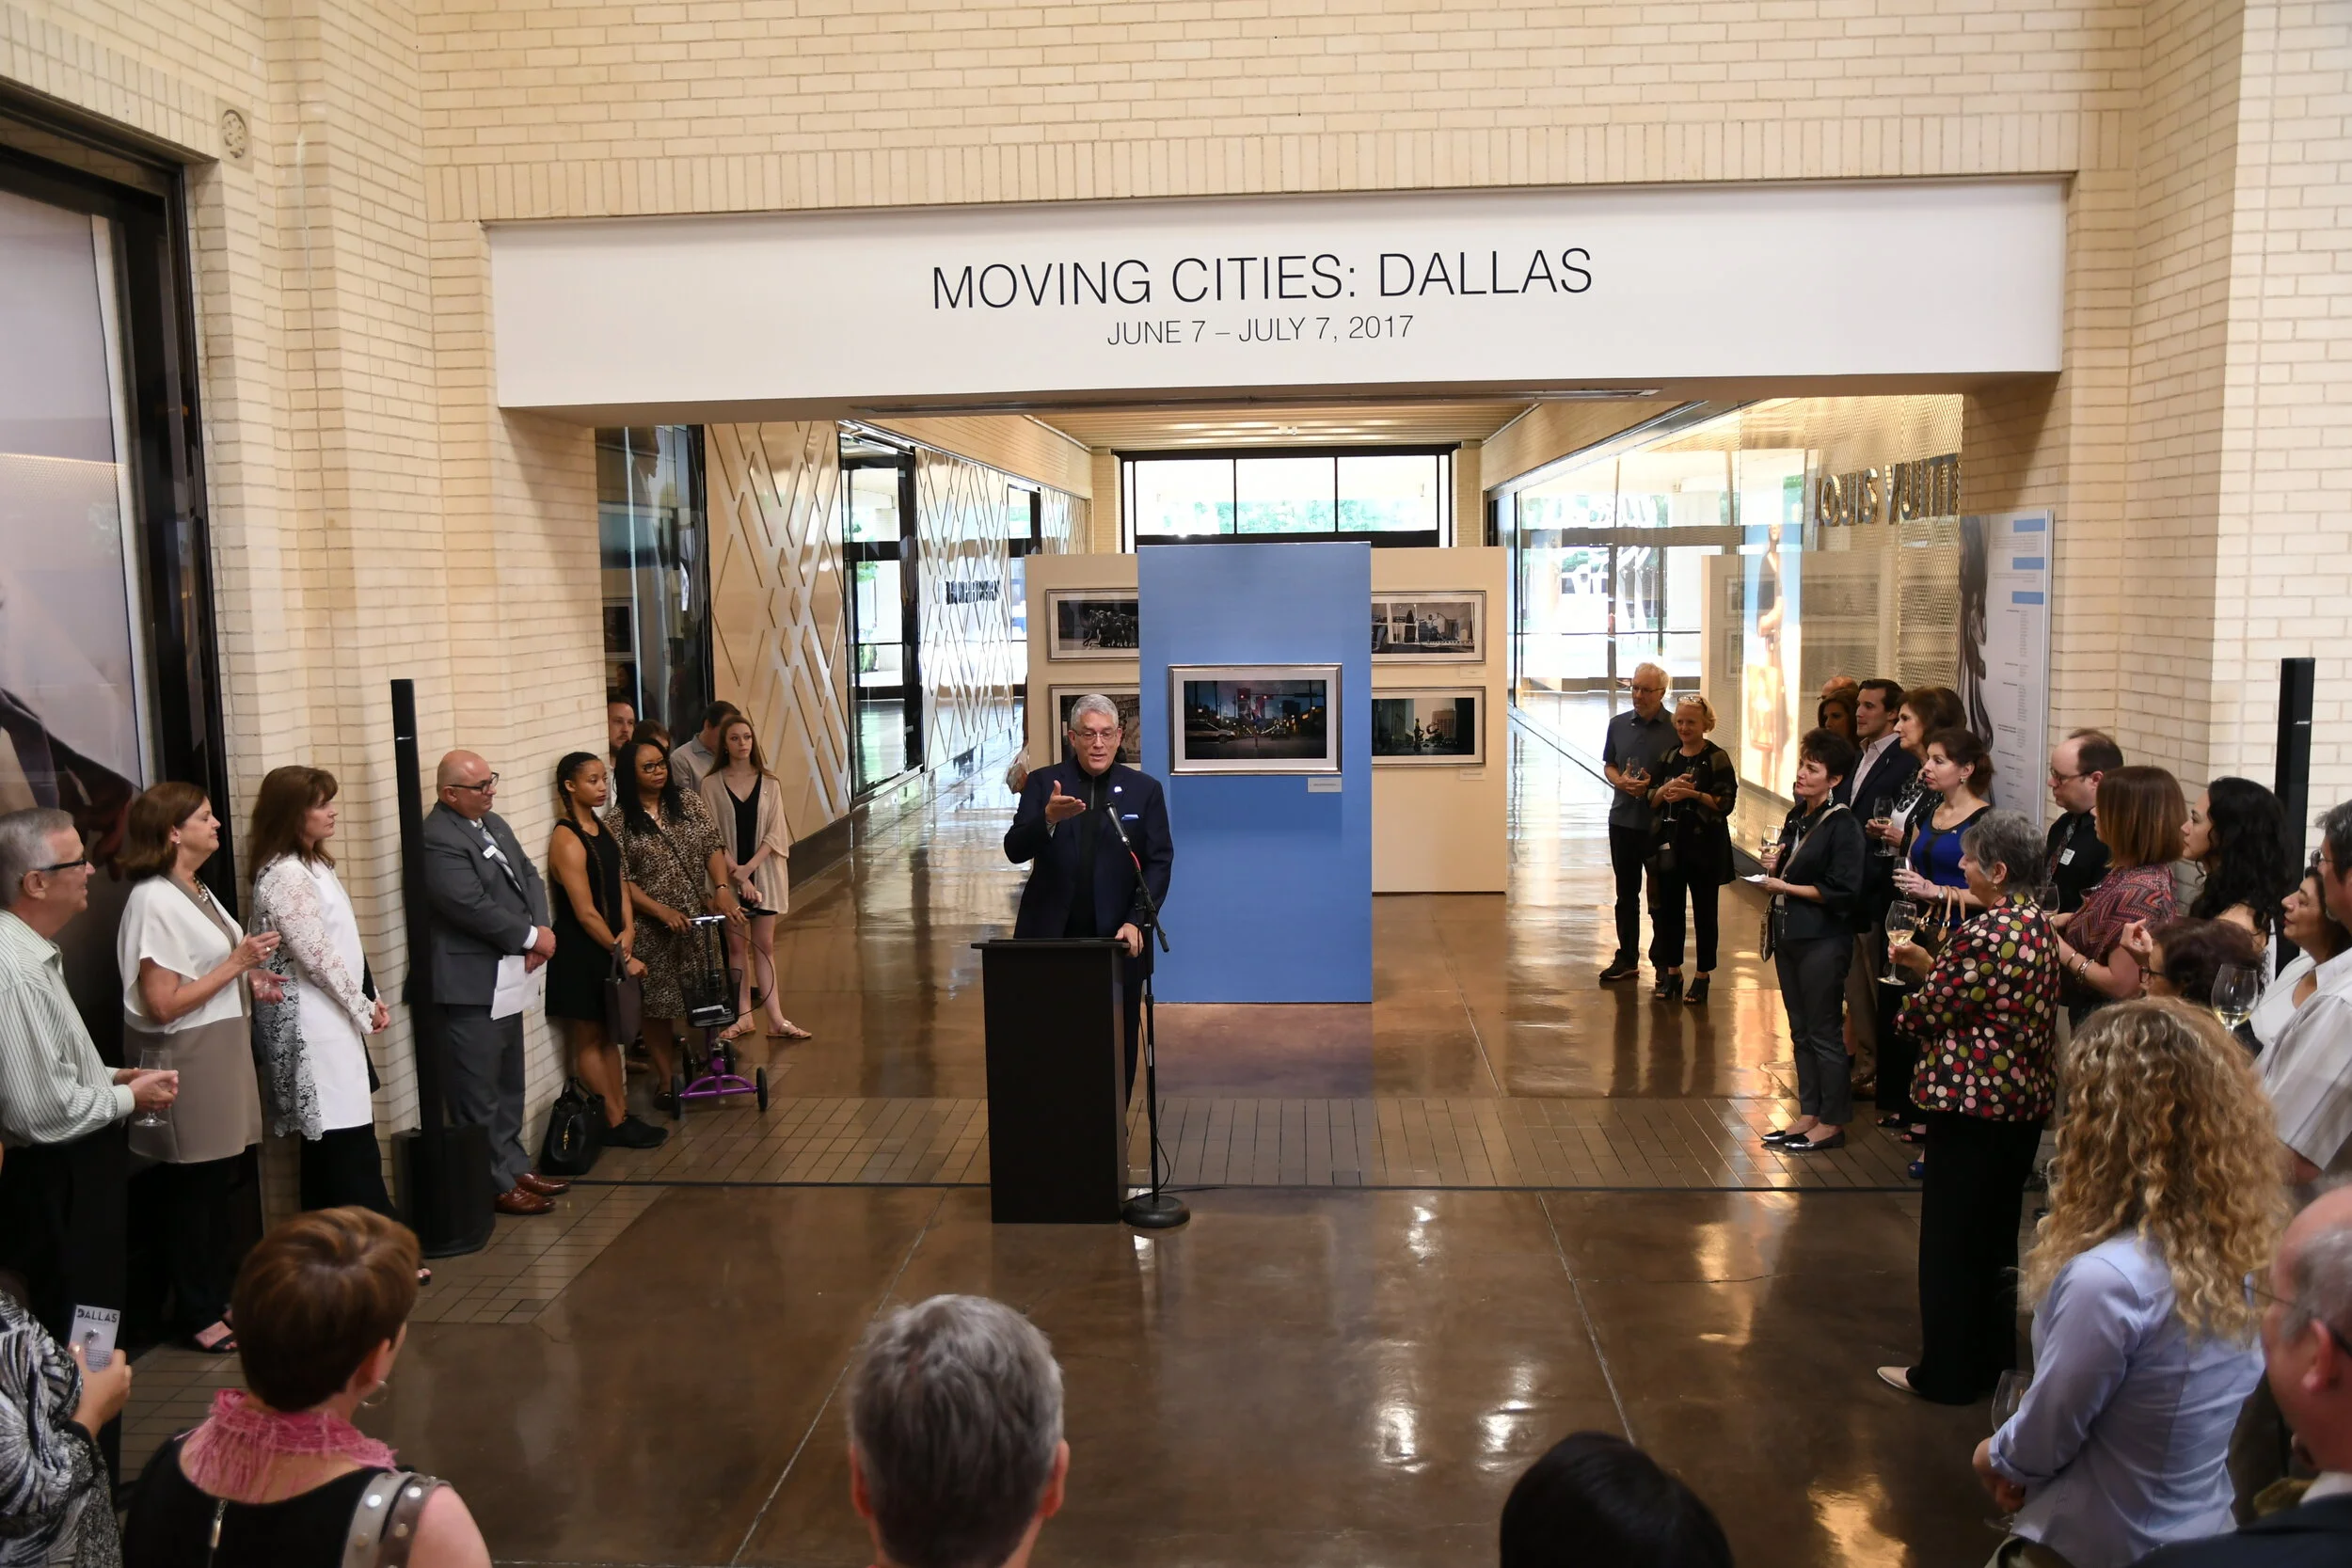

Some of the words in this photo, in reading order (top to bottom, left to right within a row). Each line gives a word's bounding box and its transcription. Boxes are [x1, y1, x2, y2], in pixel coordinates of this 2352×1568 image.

[933, 259, 1151, 309] MOVING
[1172, 253, 1355, 303] CITIES:
[1380, 247, 1592, 297] DALLAS
[1107, 320, 1182, 345] JUNE
[1191, 320, 1206, 343] 7
[1238, 317, 1306, 342] JULY
[1315, 317, 1339, 344] 7,
[1349, 315, 1414, 340] 2017
[77, 1308, 118, 1323] DALLAS
